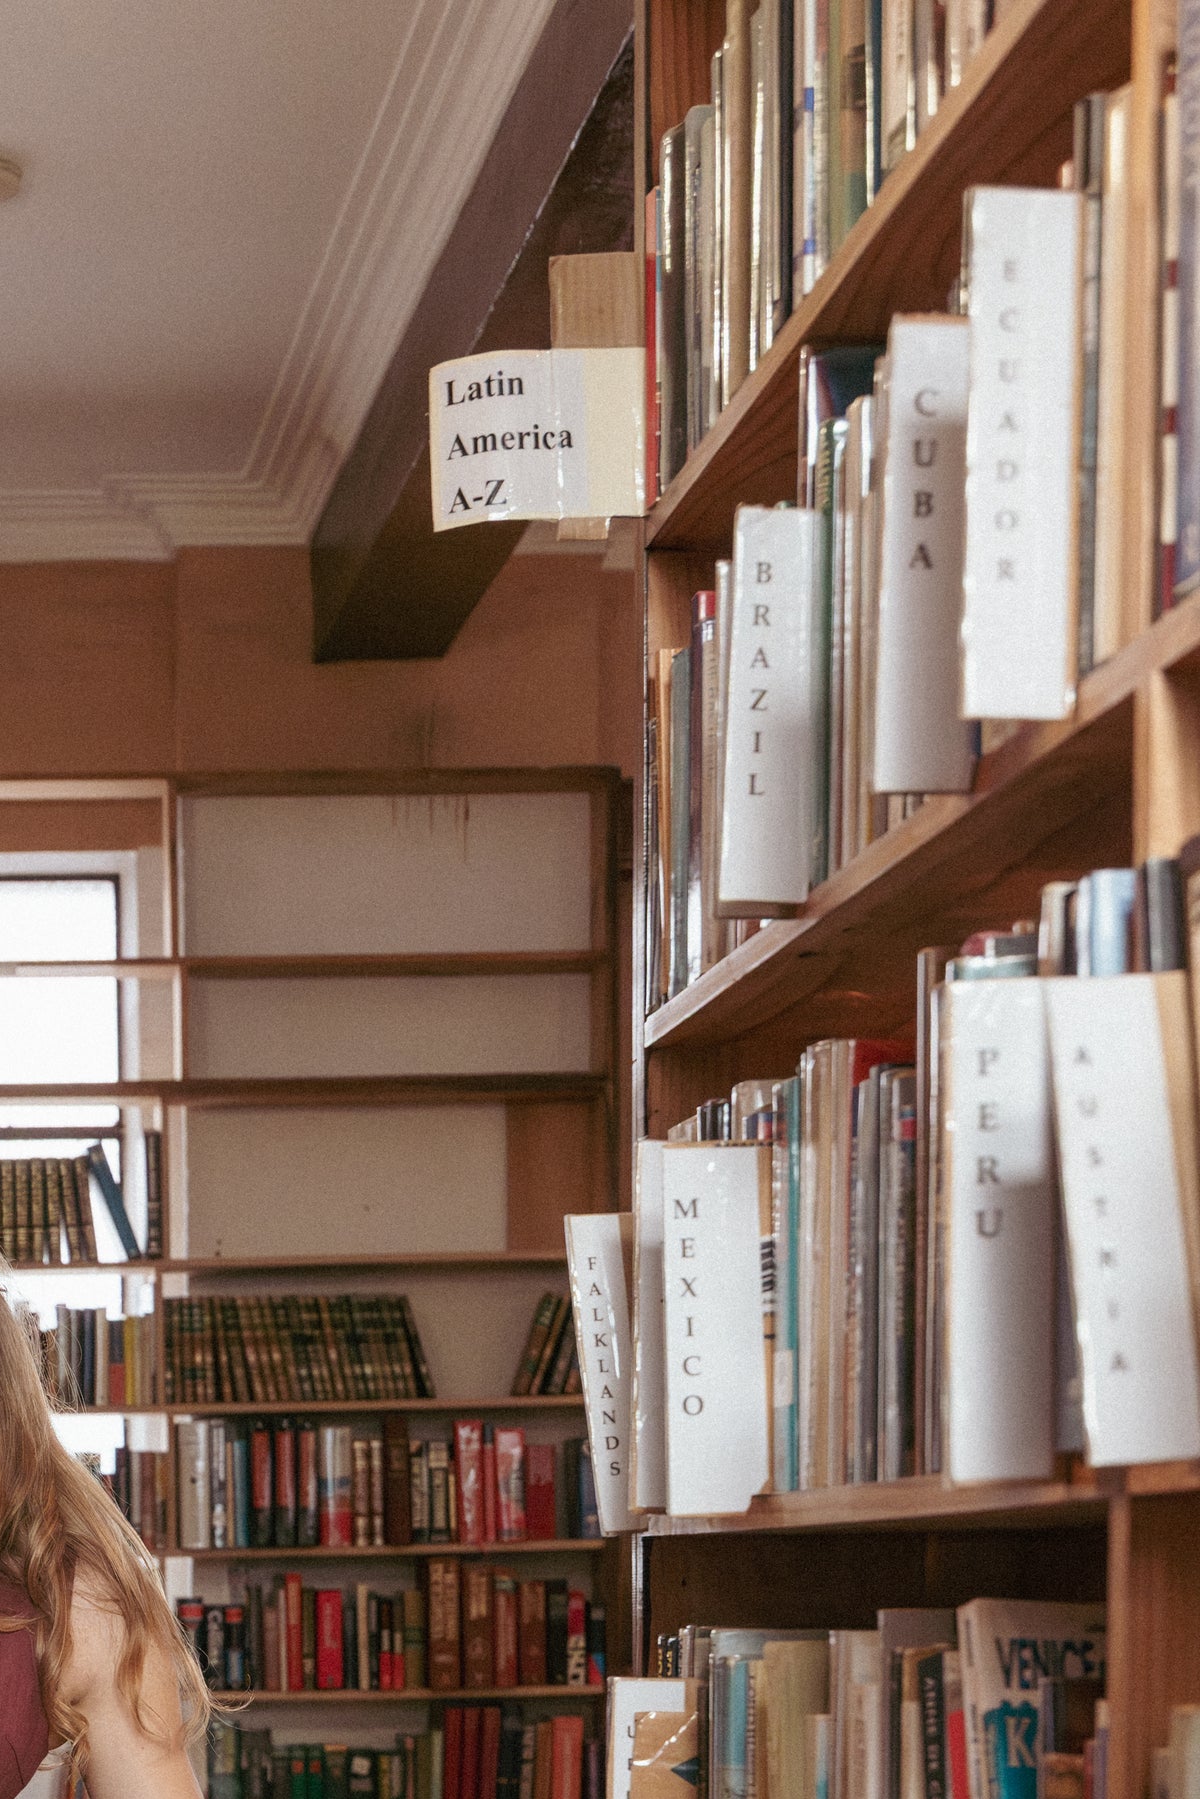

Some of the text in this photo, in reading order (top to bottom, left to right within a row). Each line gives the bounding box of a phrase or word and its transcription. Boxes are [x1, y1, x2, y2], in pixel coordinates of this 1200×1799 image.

[445, 370, 524, 407] Latin
[446, 424, 573, 460] America
[909, 388, 938, 570] CUBA
[994, 259, 1019, 582] ECUADOR
[449, 479, 507, 514] A-Z
[748, 561, 774, 796] BRAZIL
[976, 1047, 1002, 1239] PERU
[588, 1256, 621, 1476] FALKLANDS
[673, 1198, 704, 1416] MEXICO
